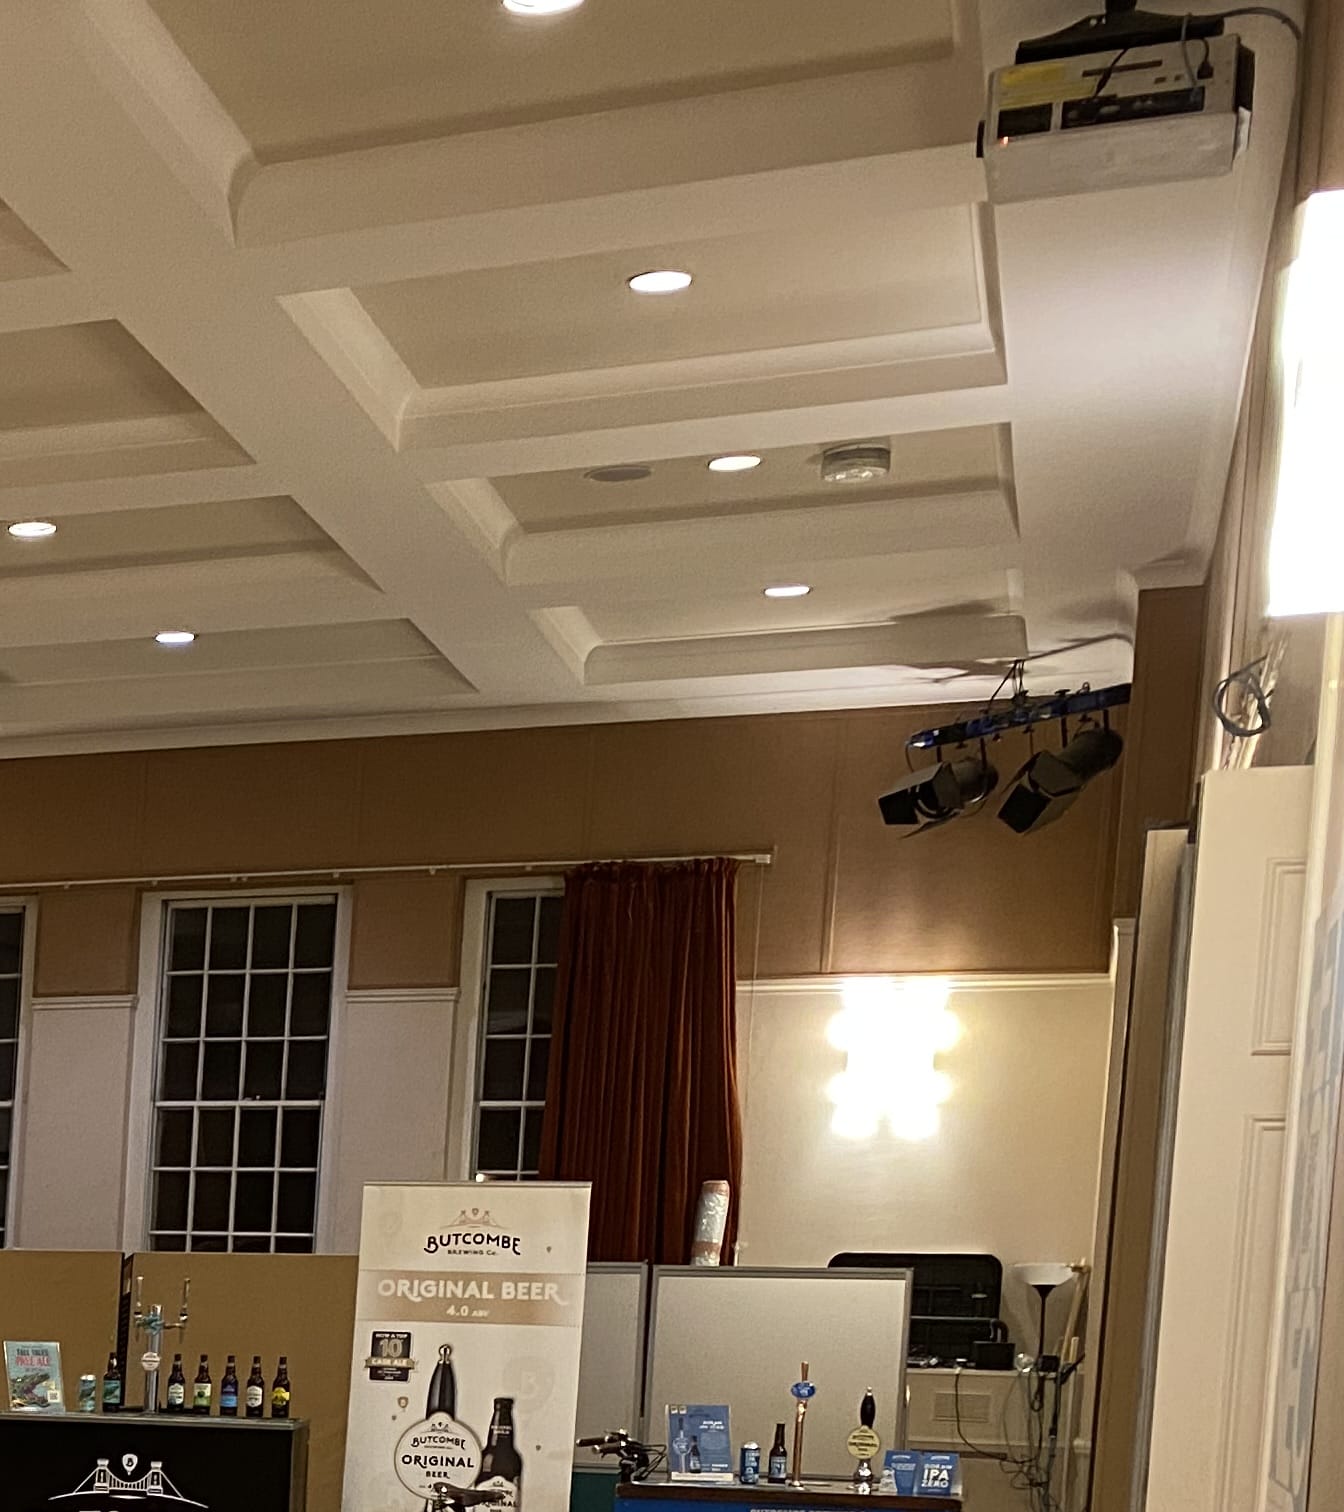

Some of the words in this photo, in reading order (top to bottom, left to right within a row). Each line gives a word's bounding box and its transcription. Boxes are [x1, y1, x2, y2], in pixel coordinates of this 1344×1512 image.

[424, 1233, 520, 1255] BUTCOMBE
[378, 1279, 495, 1302] ORIGINAL
[501, 1281, 569, 1305] BEER
[446, 1305, 469, 1316] 4.0
[380, 1339, 403, 1358] 10
[411, 1436, 466, 1450] BUTCOMBE
[402, 1454, 474, 1468] ORIGINAL
[426, 1471, 450, 1479] BEER
[923, 1469, 949, 1482] IPA
[921, 1480, 949, 1488] ZERO
